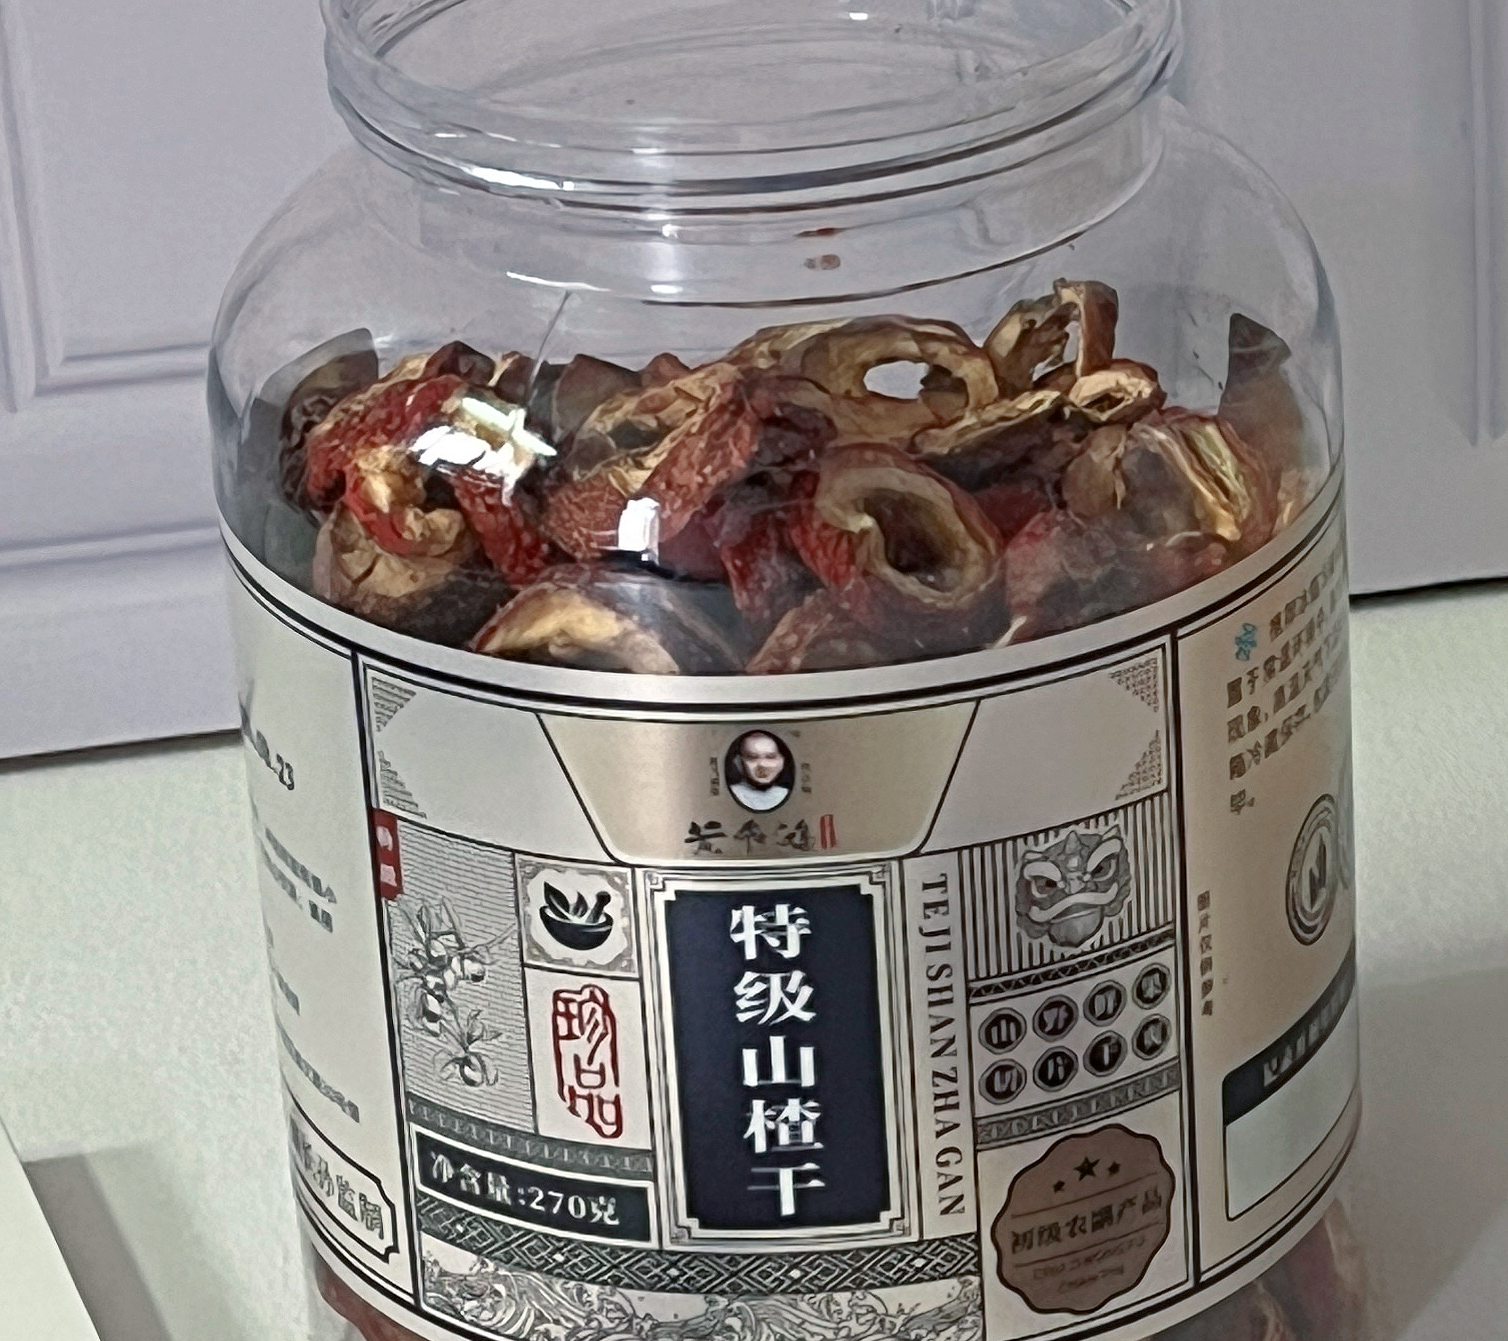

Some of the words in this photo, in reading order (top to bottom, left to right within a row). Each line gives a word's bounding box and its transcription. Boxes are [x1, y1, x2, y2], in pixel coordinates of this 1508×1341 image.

[919, 872, 951, 953] TEJI
[926, 963, 957, 1058] SHAN
[730, 904, 825, 1216] 特级山楂干
[932, 1066, 960, 1139] ZHA
[935, 1145, 965, 1216] GAN
